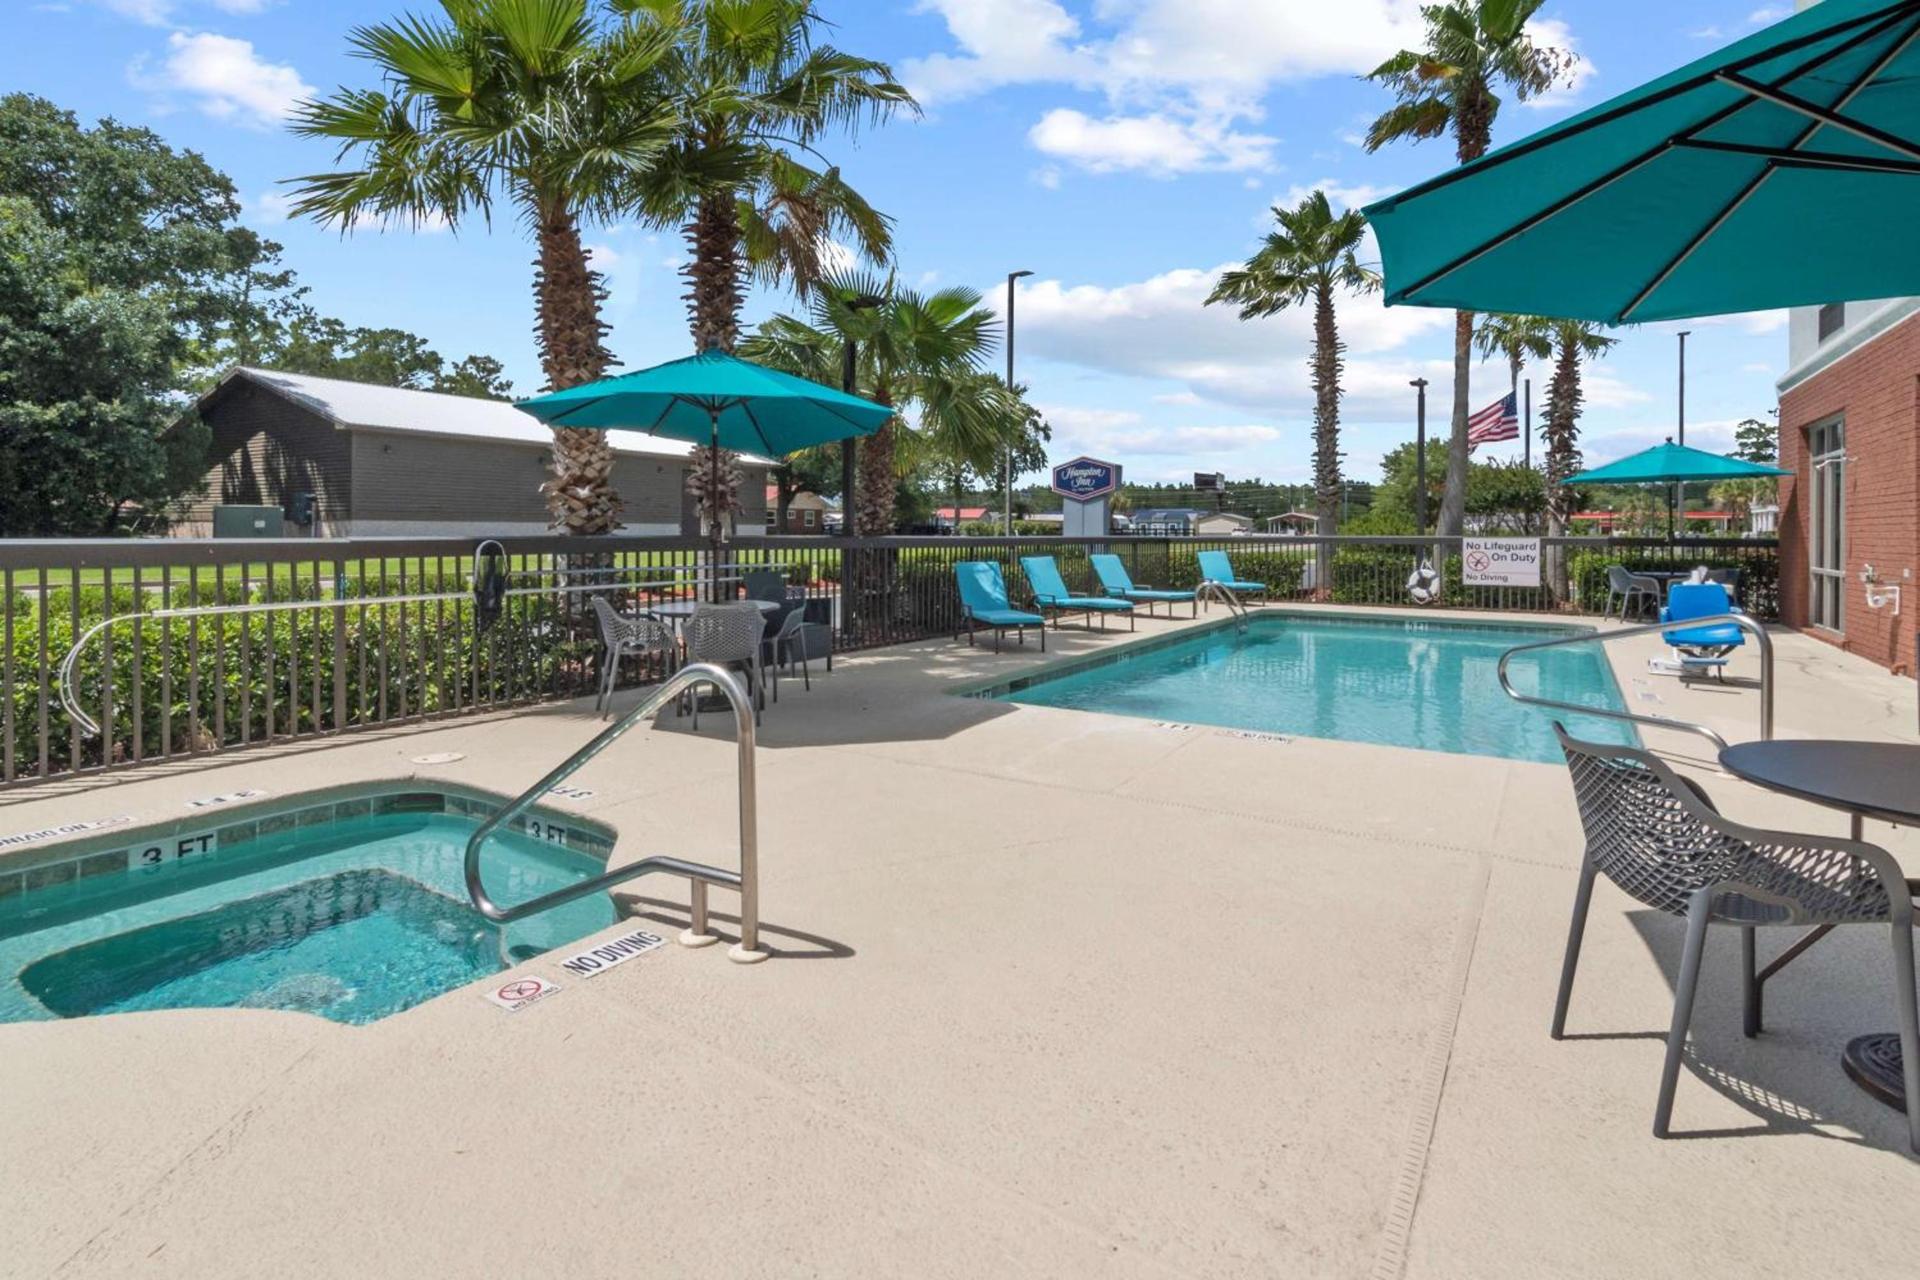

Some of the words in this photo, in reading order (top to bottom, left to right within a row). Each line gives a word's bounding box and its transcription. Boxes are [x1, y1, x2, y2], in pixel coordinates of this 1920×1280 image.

[1061, 467, 1105, 480] Hampton
[1071, 477, 1095, 488] Inn
[1466, 542, 1481, 550] No
[1484, 542, 1537, 552] Lifeguard
[1491, 553, 1507, 562] On
[1511, 553, 1536, 564] Duty
[1480, 574, 1509, 582] Diving
[59, 823, 89, 833] NO
[531, 821, 540, 838] 3
[547, 824, 565, 844] FT
[142, 847, 162, 867] 3
[178, 834, 214, 859] FT
[563, 957, 601, 975] NO
[599, 931, 662, 962] DIVING
